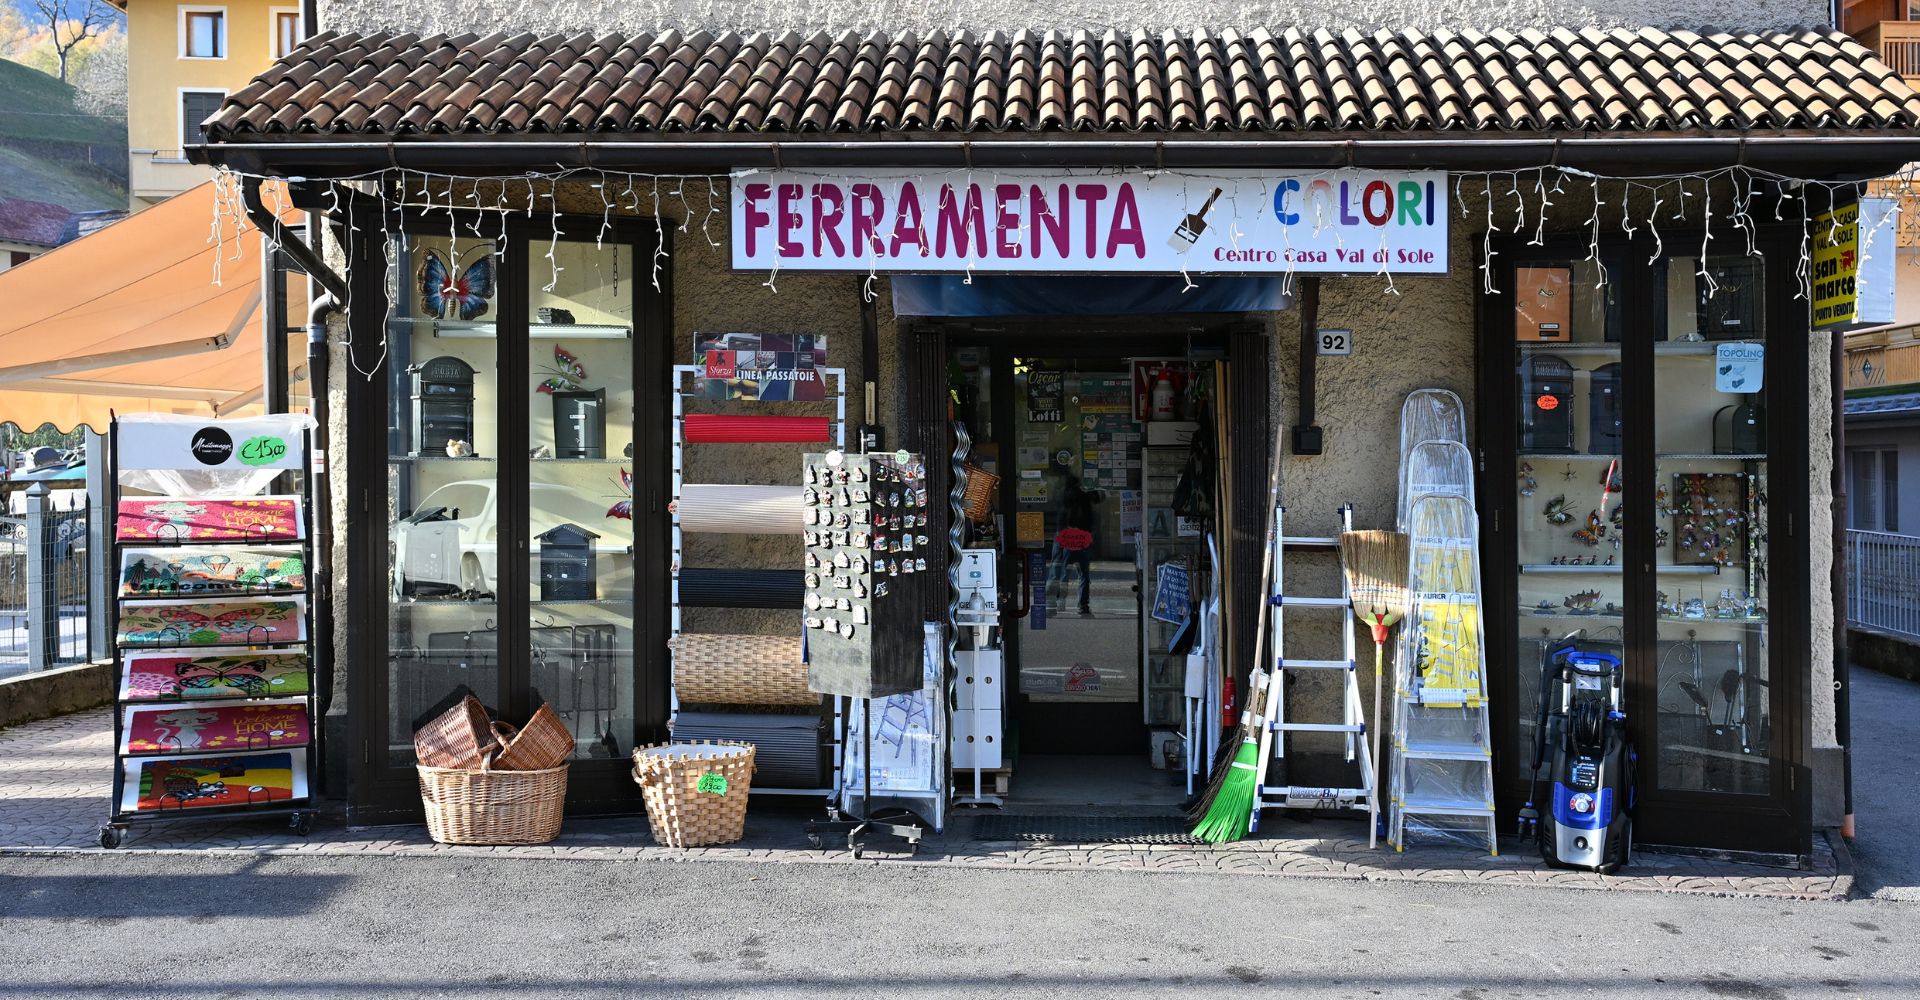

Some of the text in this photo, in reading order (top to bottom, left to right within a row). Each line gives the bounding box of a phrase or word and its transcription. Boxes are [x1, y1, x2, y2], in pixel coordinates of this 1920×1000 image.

[1273, 179, 1435, 226] COLORI
[745, 181, 1146, 259] FERRAMENTA
[1813, 210, 1856, 235] CENTRO CASA
[1816, 237, 1828, 251] VAL
[1838, 228, 1853, 246] SOLE
[1214, 247, 1434, 264] Centro Casa Val di Sole
[1815, 257, 1838, 280] san
[1815, 276, 1855, 301] marco
[1815, 301, 1855, 321] PUNTO VENDITA
[1322, 335, 1345, 350] 92
[1719, 350, 1764, 358] TOPOLINO
[709, 366, 732, 376] Sforza
[736, 370, 815, 382] LINEA PASSATOIE
[241, 443, 255, 459] €
[225, 515, 288, 527] HOME
[236, 720, 297, 734] HOME
